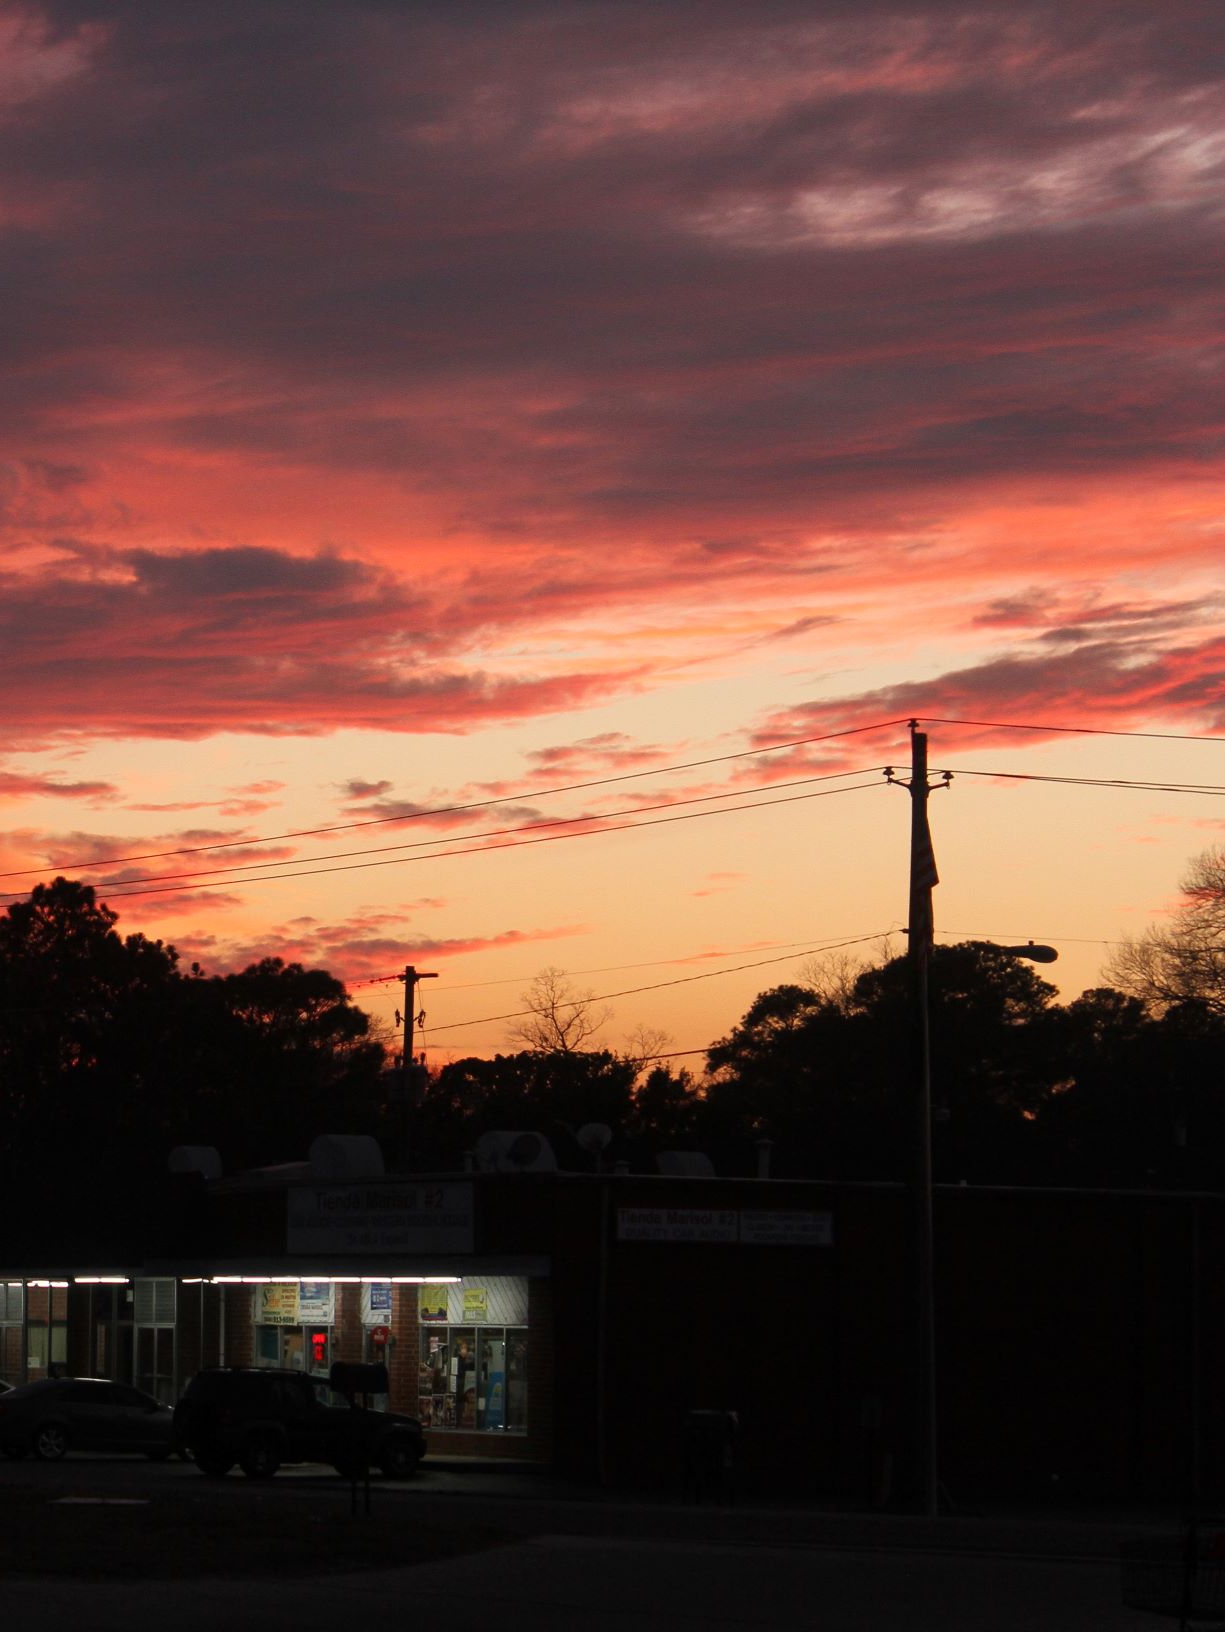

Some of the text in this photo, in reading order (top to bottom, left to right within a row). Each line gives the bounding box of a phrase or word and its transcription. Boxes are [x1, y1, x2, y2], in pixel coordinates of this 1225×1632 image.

[619, 1210, 661, 1225] Tienda
[666, 1210, 713, 1225] Marisol
[719, 1211, 737, 1226] #2
